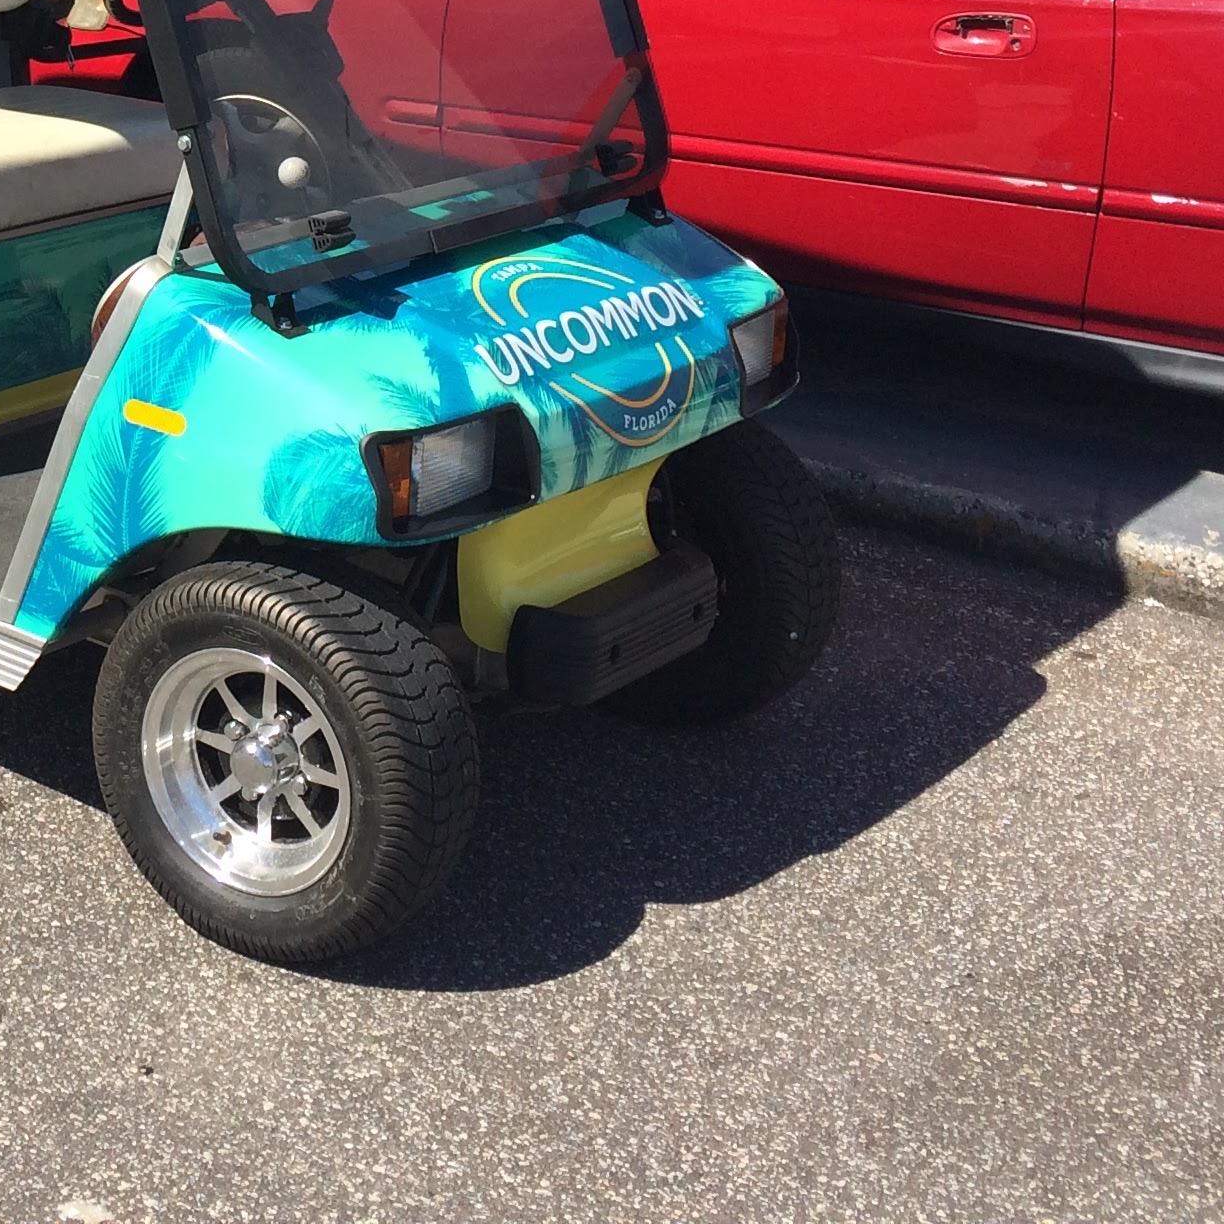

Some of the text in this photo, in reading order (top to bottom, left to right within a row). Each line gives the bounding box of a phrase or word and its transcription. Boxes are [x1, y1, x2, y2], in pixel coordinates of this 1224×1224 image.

[490, 262, 544, 281] TAMPA
[473, 282, 705, 385] UNCOMMON
[623, 398, 677, 431] FLORIDA
